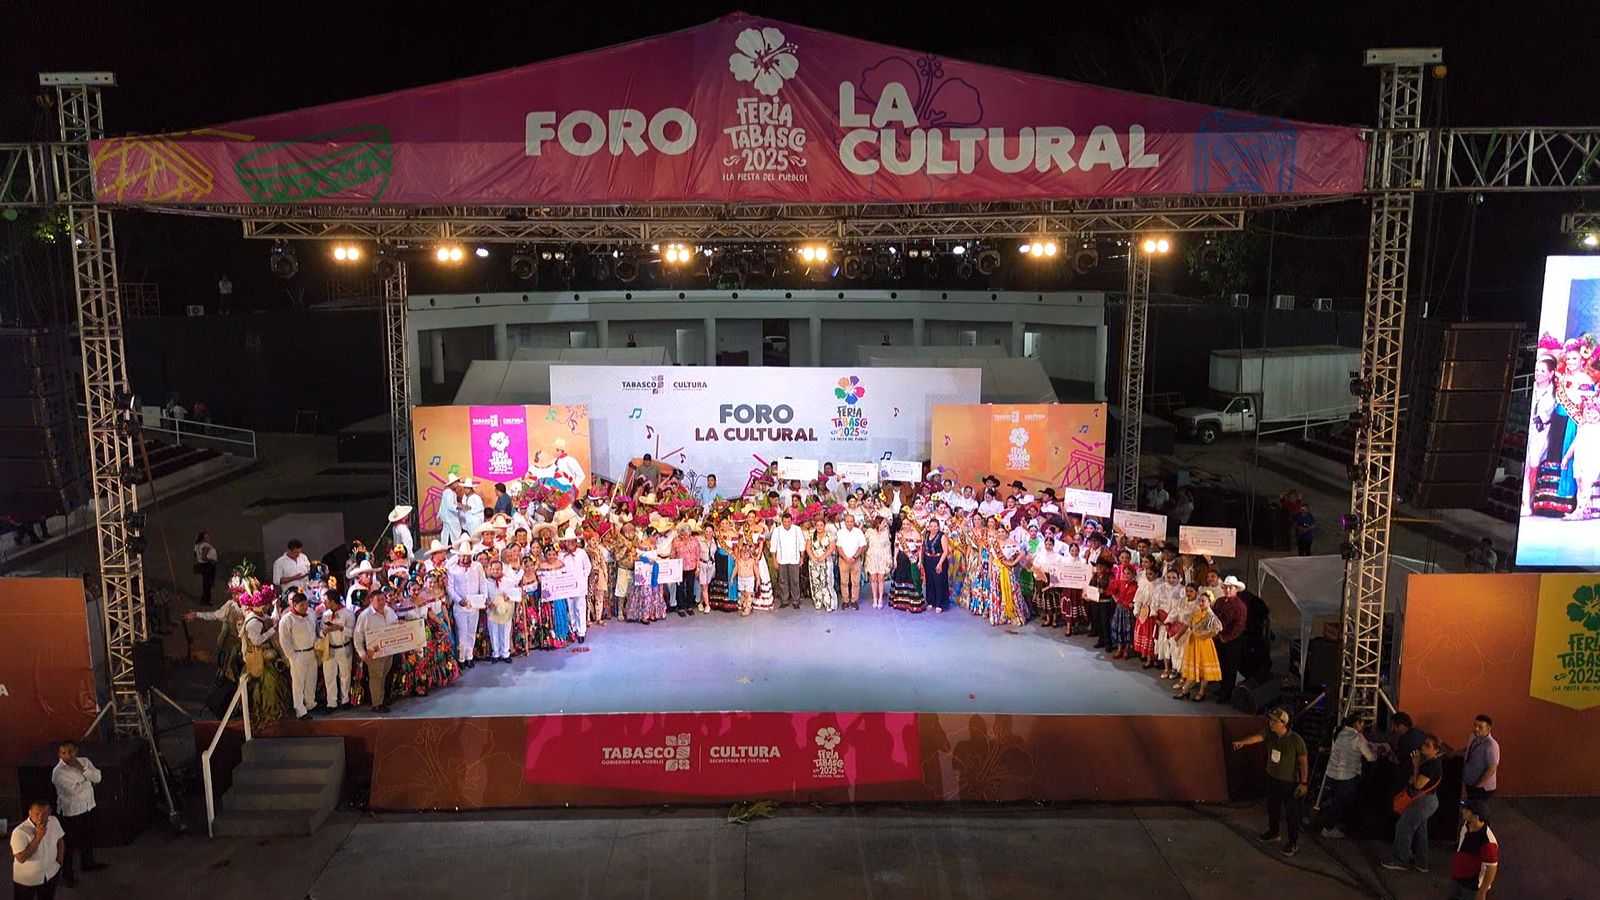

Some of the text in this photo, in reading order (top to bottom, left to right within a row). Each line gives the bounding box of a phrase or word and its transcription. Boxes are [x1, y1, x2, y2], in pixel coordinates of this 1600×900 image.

[839, 80, 919, 129] LA
[736, 97, 793, 128] FERIA
[525, 107, 697, 157] FORO
[839, 124, 1160, 175] CULTURAL
[741, 147, 789, 171] 2025
[737, 172, 760, 182] FIESTA
[763, 173, 775, 182] DEL
[719, 404, 794, 424] FORO
[837, 405, 863, 418] FERIA
[695, 427, 818, 442] LA CULTURAL
[838, 427, 861, 437] 2025
[602, 746, 781, 759] TABASCO CULTURA
[817, 749, 839, 760] FERIA
[820, 766, 838, 775] 2025
